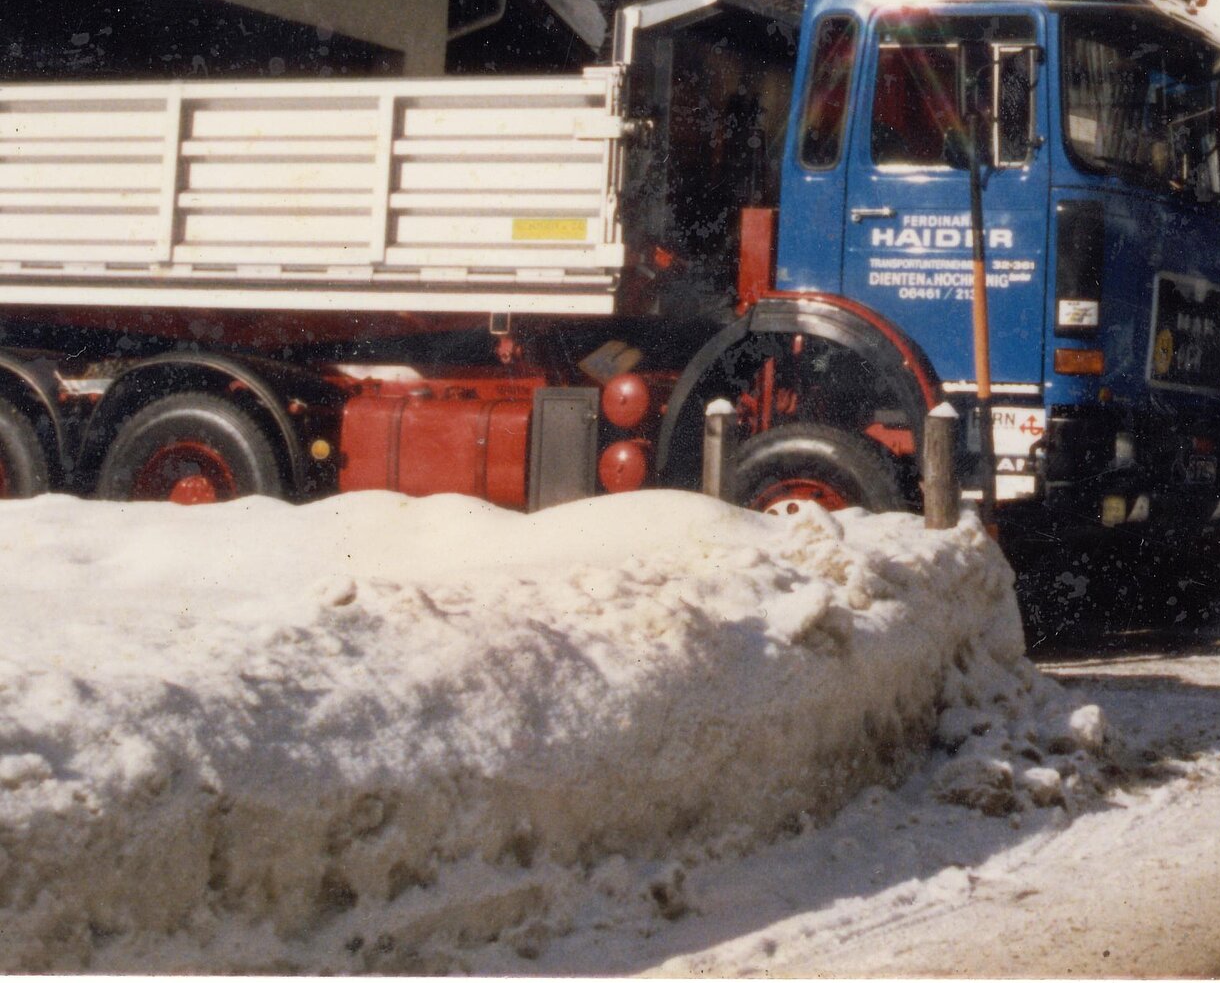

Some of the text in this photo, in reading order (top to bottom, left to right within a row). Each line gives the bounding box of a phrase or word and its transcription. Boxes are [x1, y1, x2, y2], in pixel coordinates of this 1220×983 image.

[903, 215, 973, 227] FERDINAN
[869, 272, 925, 286] DIENTEN
[934, 273, 1009, 288] HOCHKNIG
